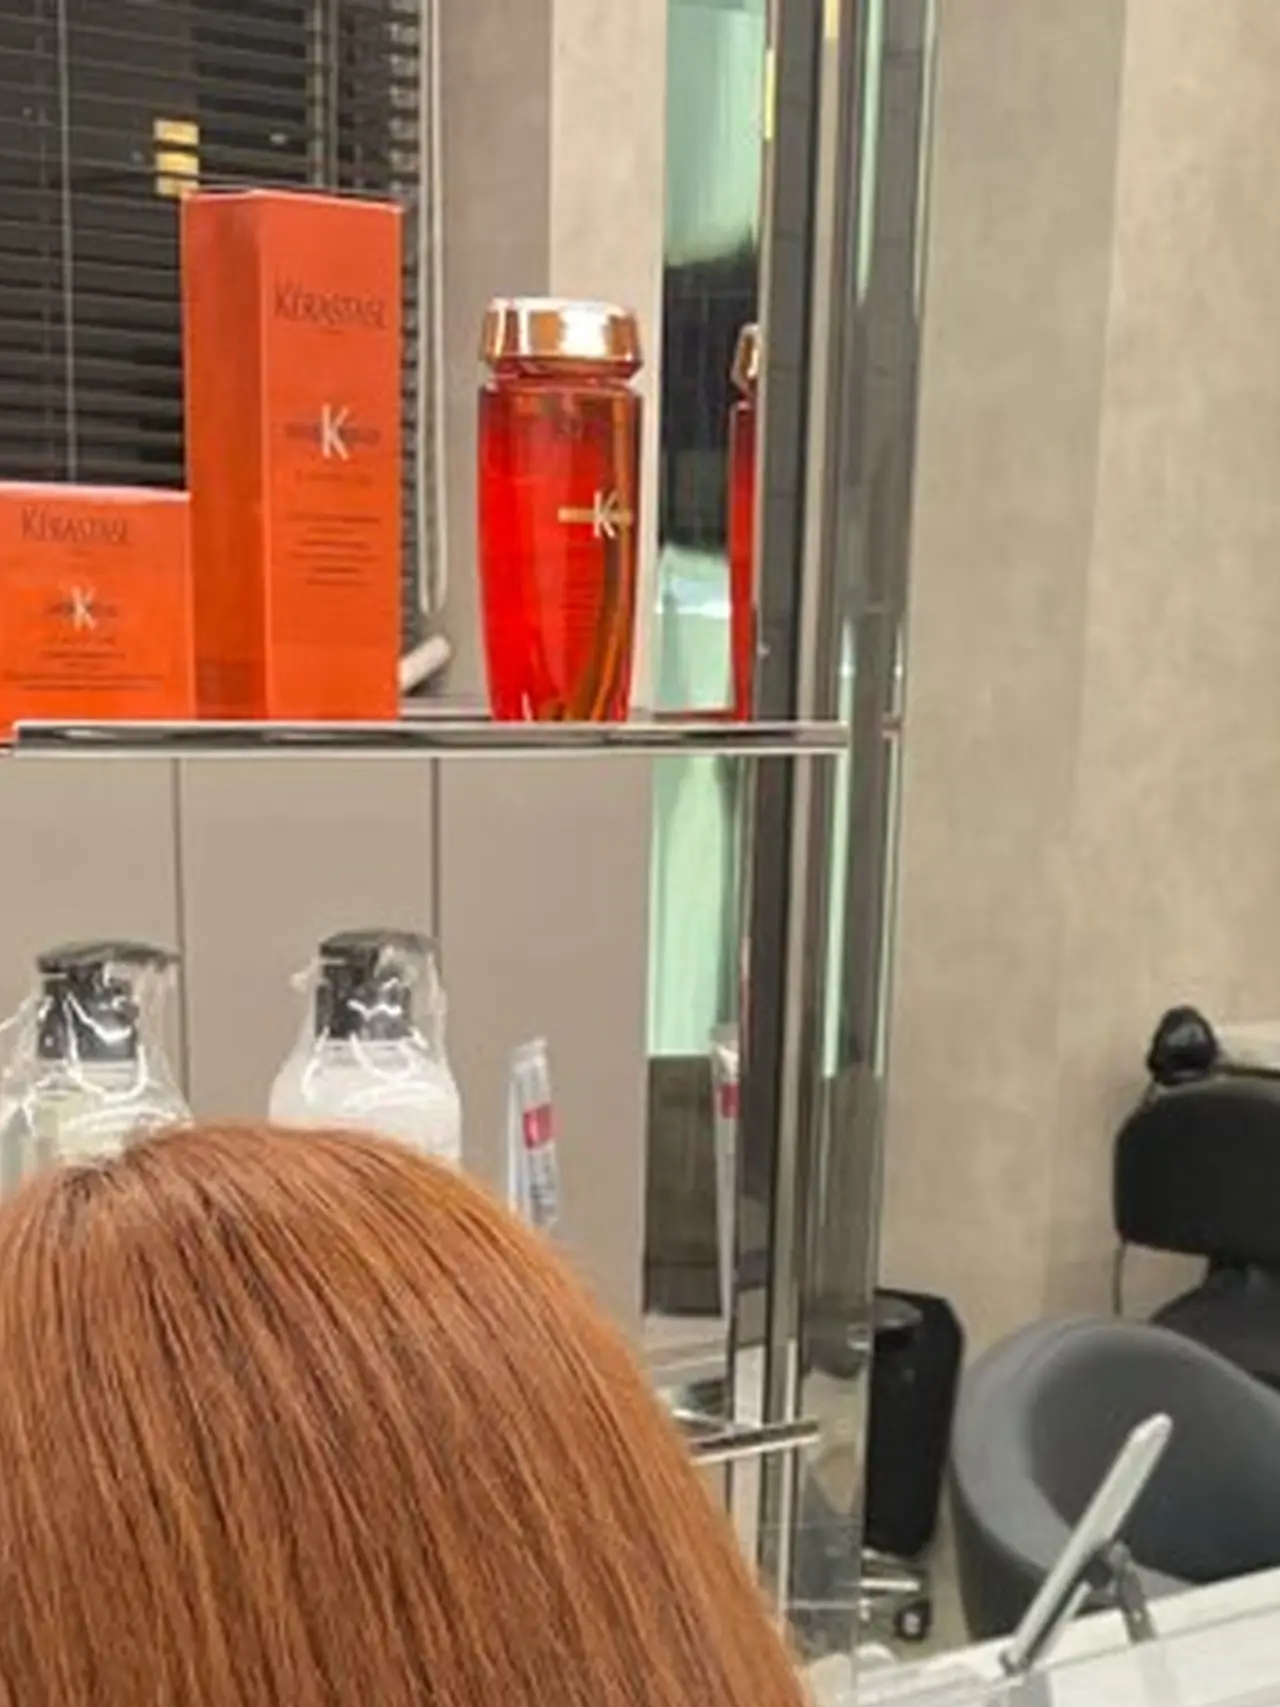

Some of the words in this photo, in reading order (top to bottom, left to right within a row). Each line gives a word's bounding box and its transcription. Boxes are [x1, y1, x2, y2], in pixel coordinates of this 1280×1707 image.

[320, 403, 350, 462] K
[593, 489, 619, 540] K
[70, 584, 98, 632] K
